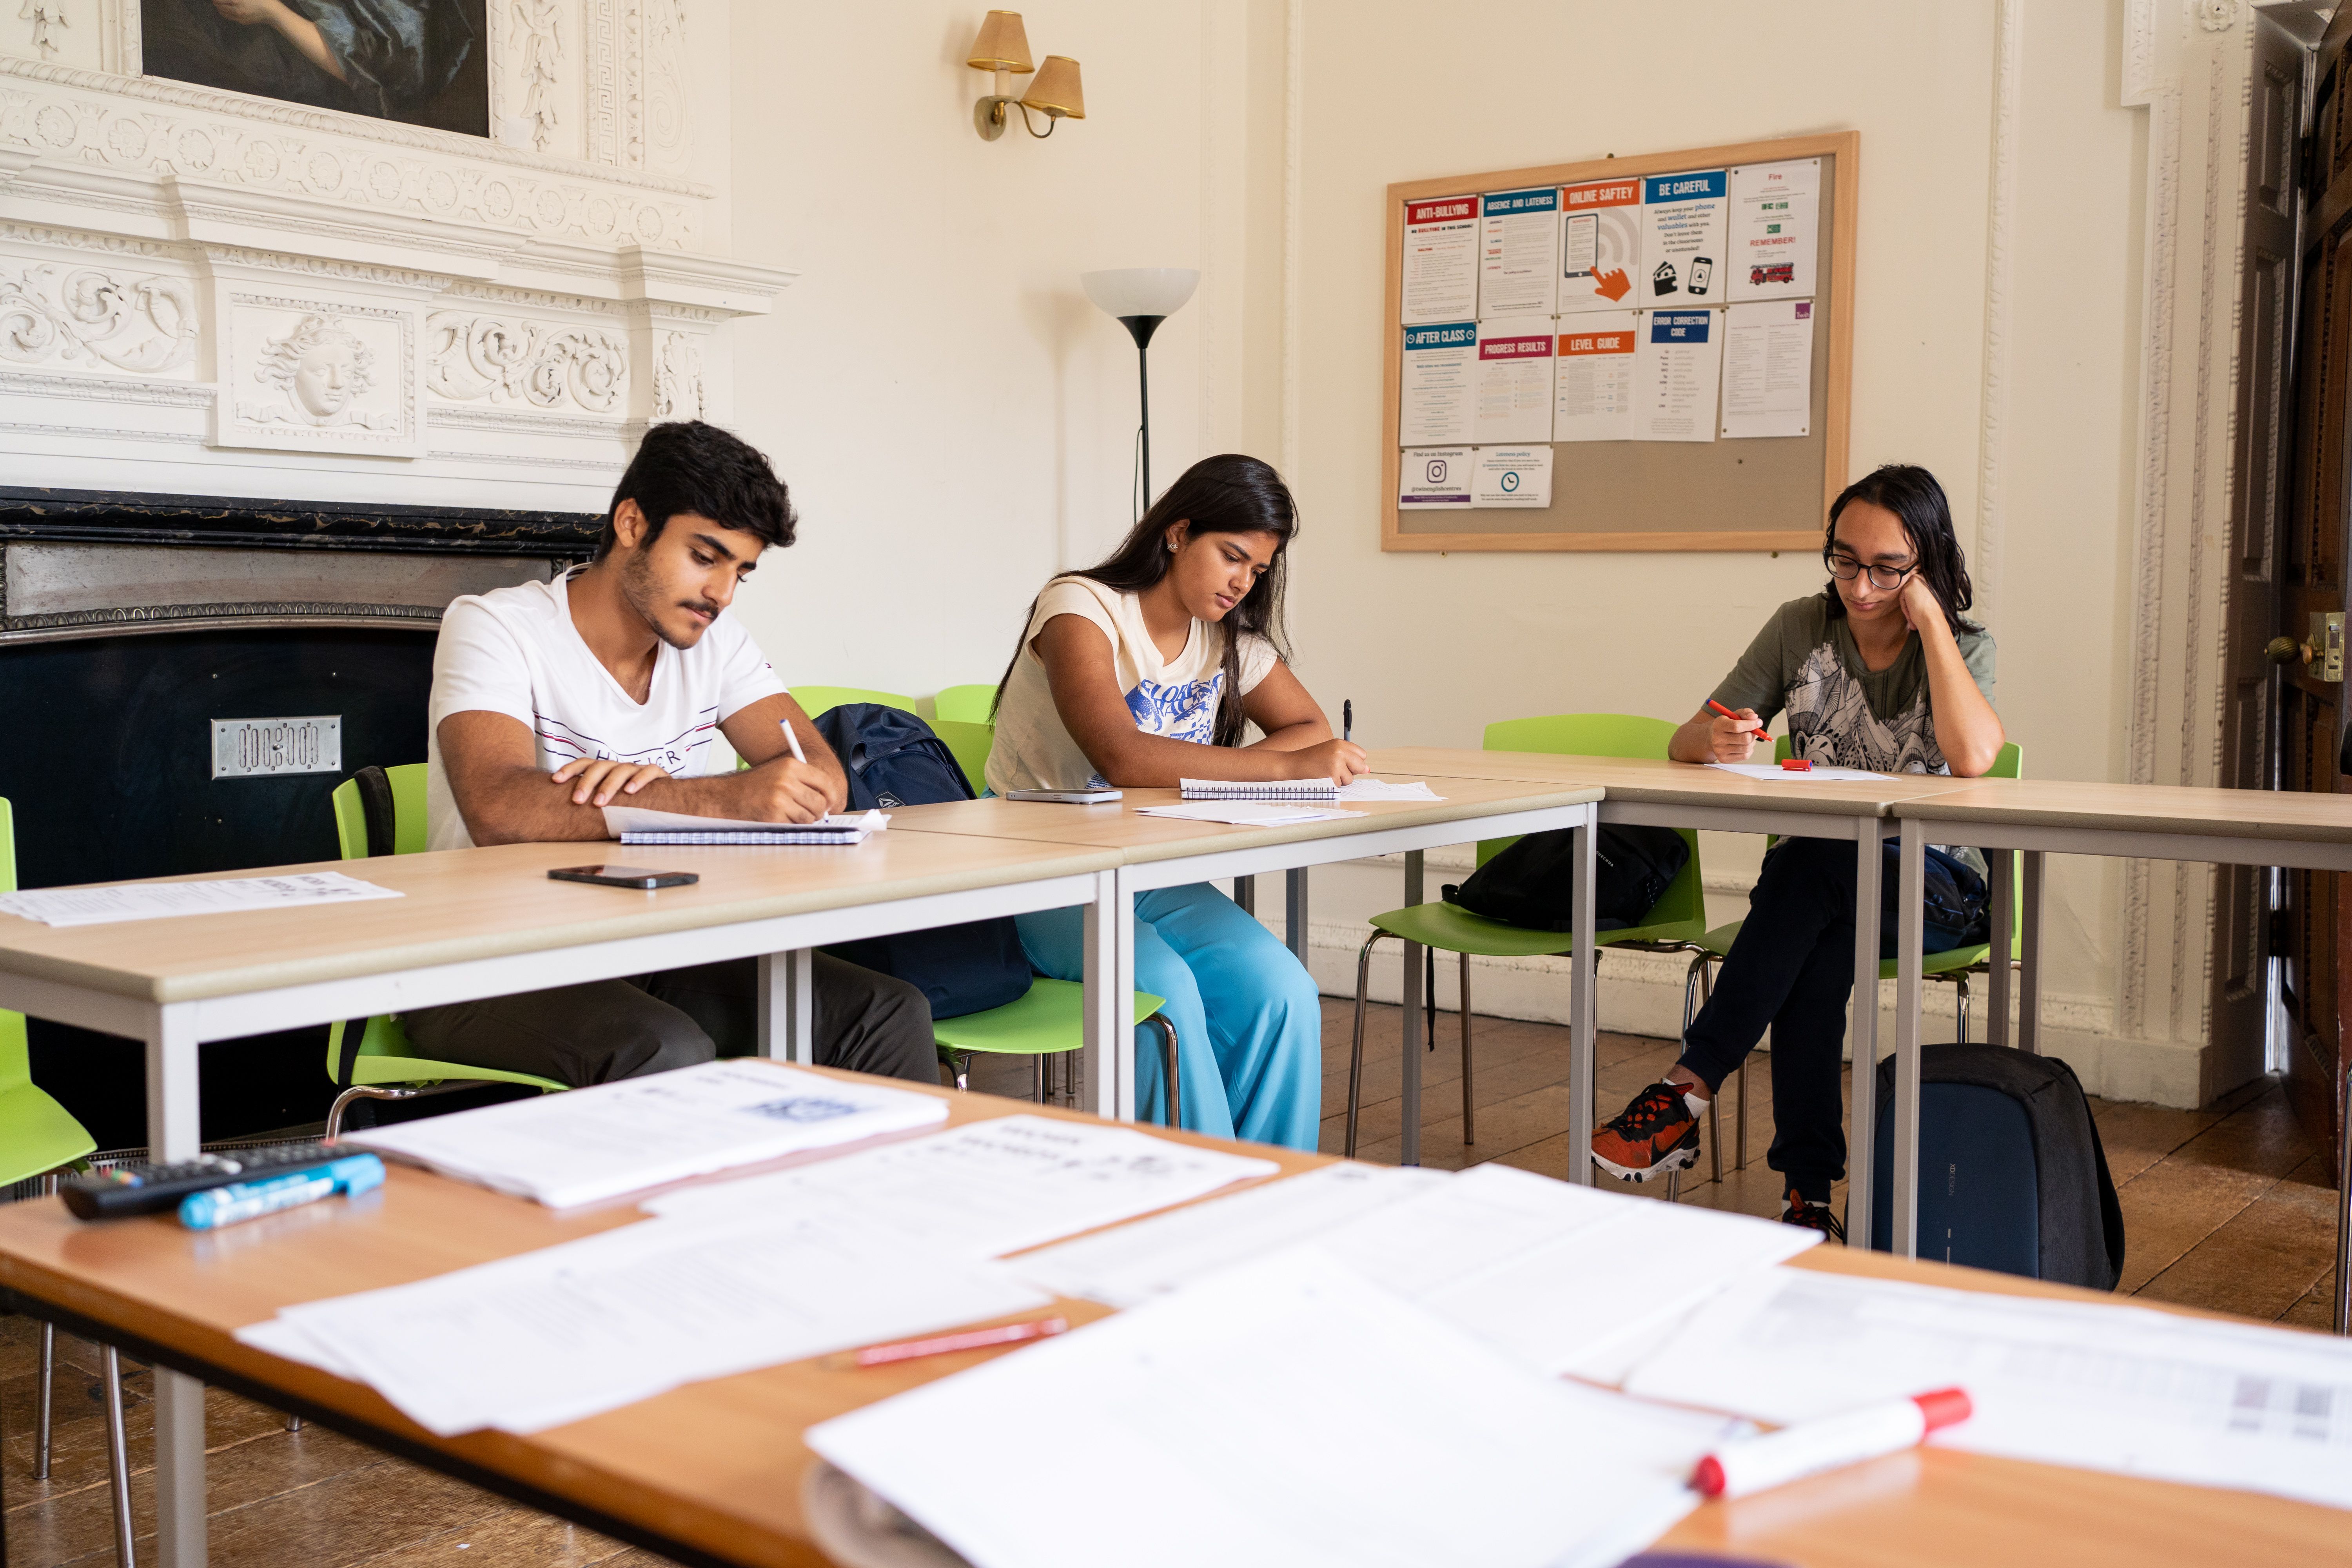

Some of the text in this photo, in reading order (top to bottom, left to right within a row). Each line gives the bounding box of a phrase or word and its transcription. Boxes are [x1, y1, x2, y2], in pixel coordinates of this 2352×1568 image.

[1659, 179, 1711, 196] BE CAREFUL
[1569, 186, 1633, 204] ONLINE SAFTEY
[1487, 196, 1553, 211] ABSENCE AND LATENESS
[1695, 203, 1715, 212] phone
[1416, 203, 1469, 220] ANTI-BULLYING
[1750, 236, 1796, 247] REMEMBER!
[1653, 316, 1709, 326] ERROR CORRECTION
[1416, 329, 1465, 344] AFTER CLASS
[1671, 328, 1686, 337] CODE
[1485, 341, 1546, 354] PROGRESS RESULTS
[1571, 337, 1621, 351] LEVEL GUIDE
